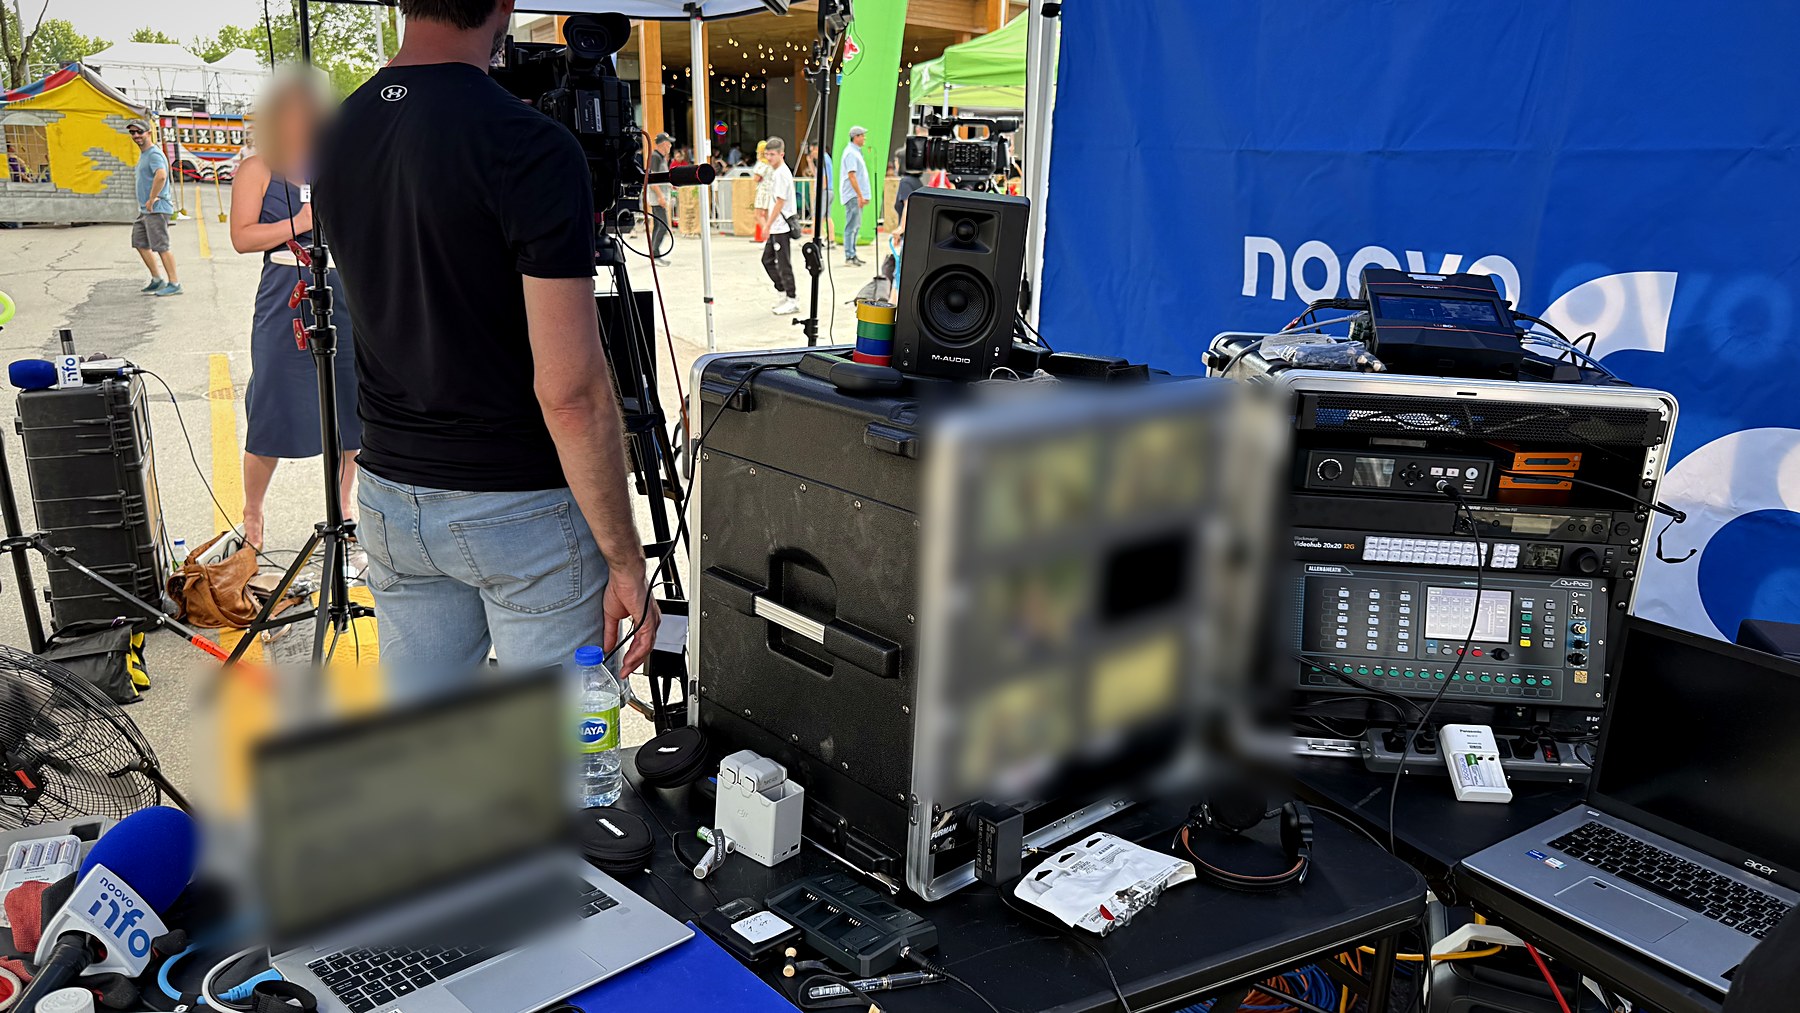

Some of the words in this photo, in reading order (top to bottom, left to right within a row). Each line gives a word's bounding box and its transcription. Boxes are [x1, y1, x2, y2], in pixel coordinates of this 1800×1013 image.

[931, 354, 971, 364] M-AUDIO
[1293, 540, 1322, 549] Videohub
[1308, 565, 1342, 573] ALLEN&HEATH
[931, 822, 958, 841] FURMAN
[1744, 858, 1778, 875] acer
[100, 877, 134, 908] noovo
[88, 892, 151, 958] info
